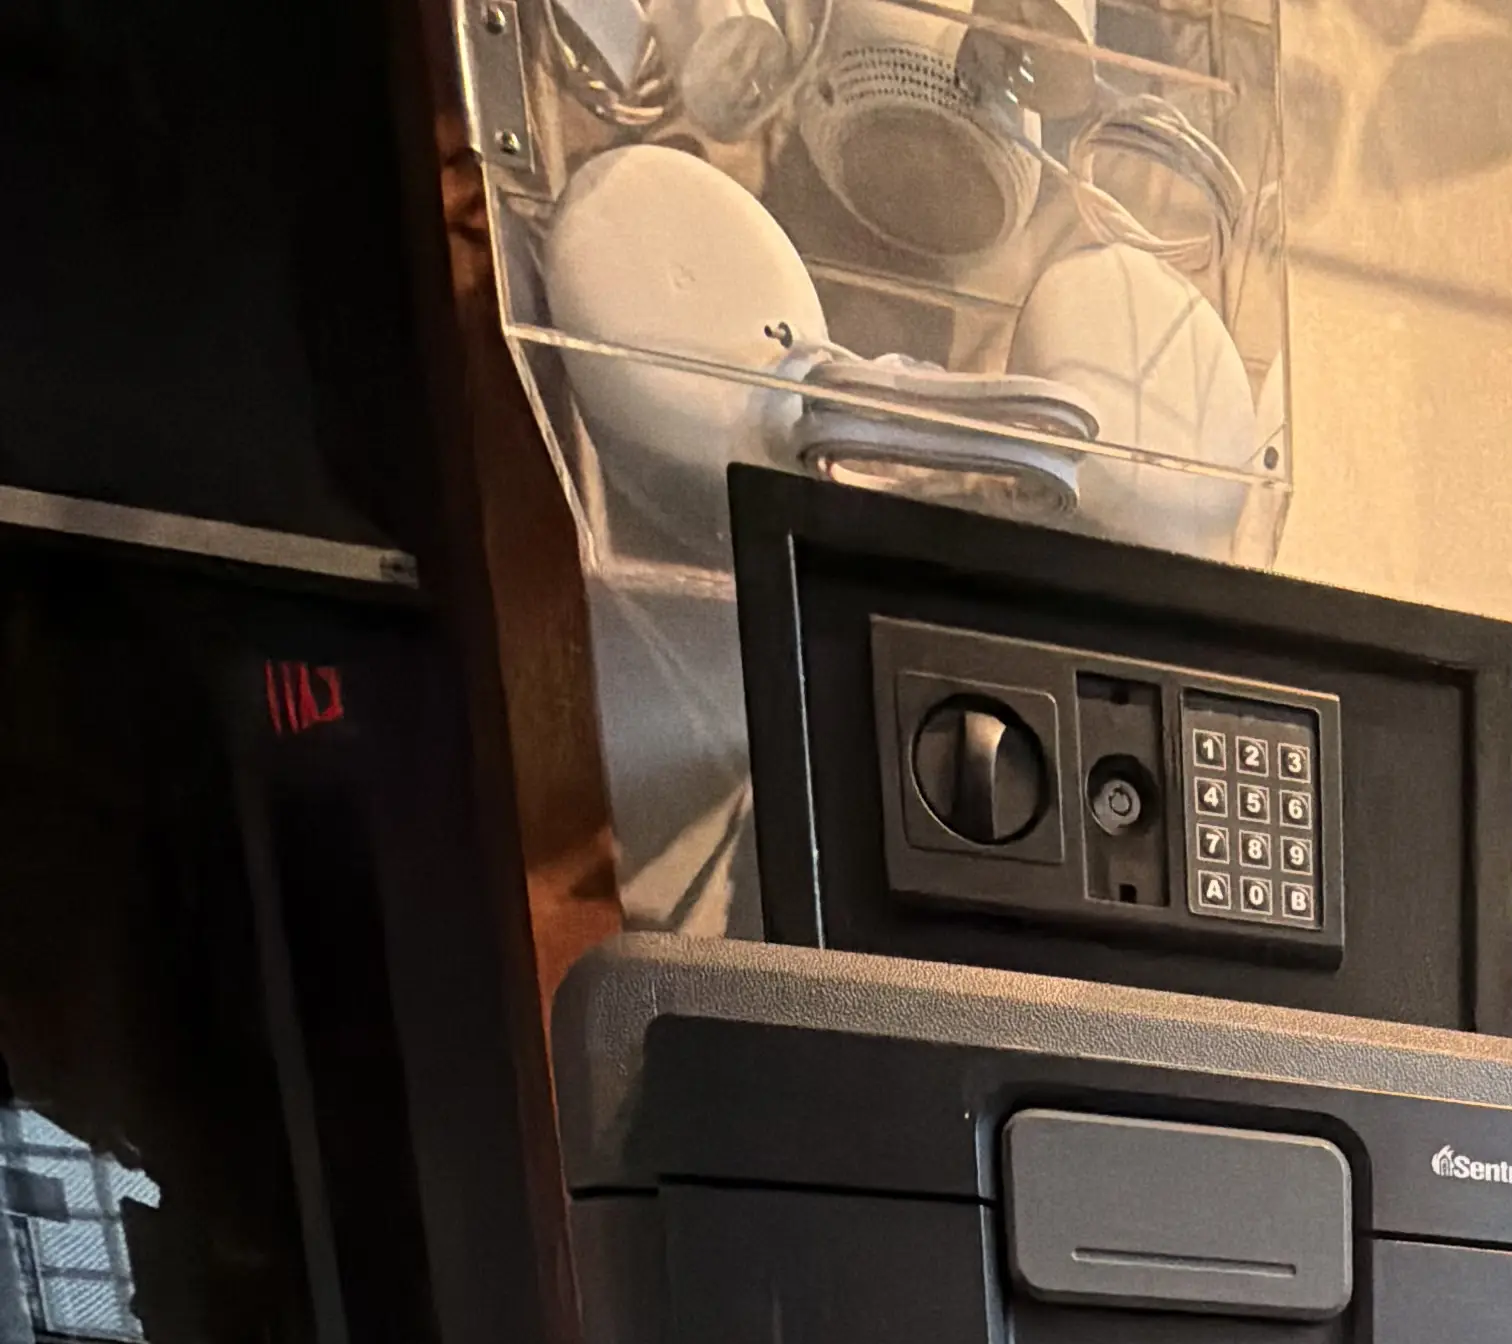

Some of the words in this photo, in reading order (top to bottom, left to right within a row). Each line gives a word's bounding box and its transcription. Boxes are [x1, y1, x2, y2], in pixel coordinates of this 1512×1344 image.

[1203, 738, 1214, 760] 1
[1245, 745, 1260, 767] 2
[1287, 752, 1302, 773] 3
[1203, 786, 1219, 807] 4
[1246, 792, 1261, 813] 5
[1288, 799, 1303, 820] 6
[1205, 833, 1220, 854] 7
[1248, 838, 1262, 860] 8
[1289, 845, 1304, 866] 9
[1206, 880, 1223, 900] A
[1249, 885, 1264, 906] 0
[1291, 891, 1307, 911] B
